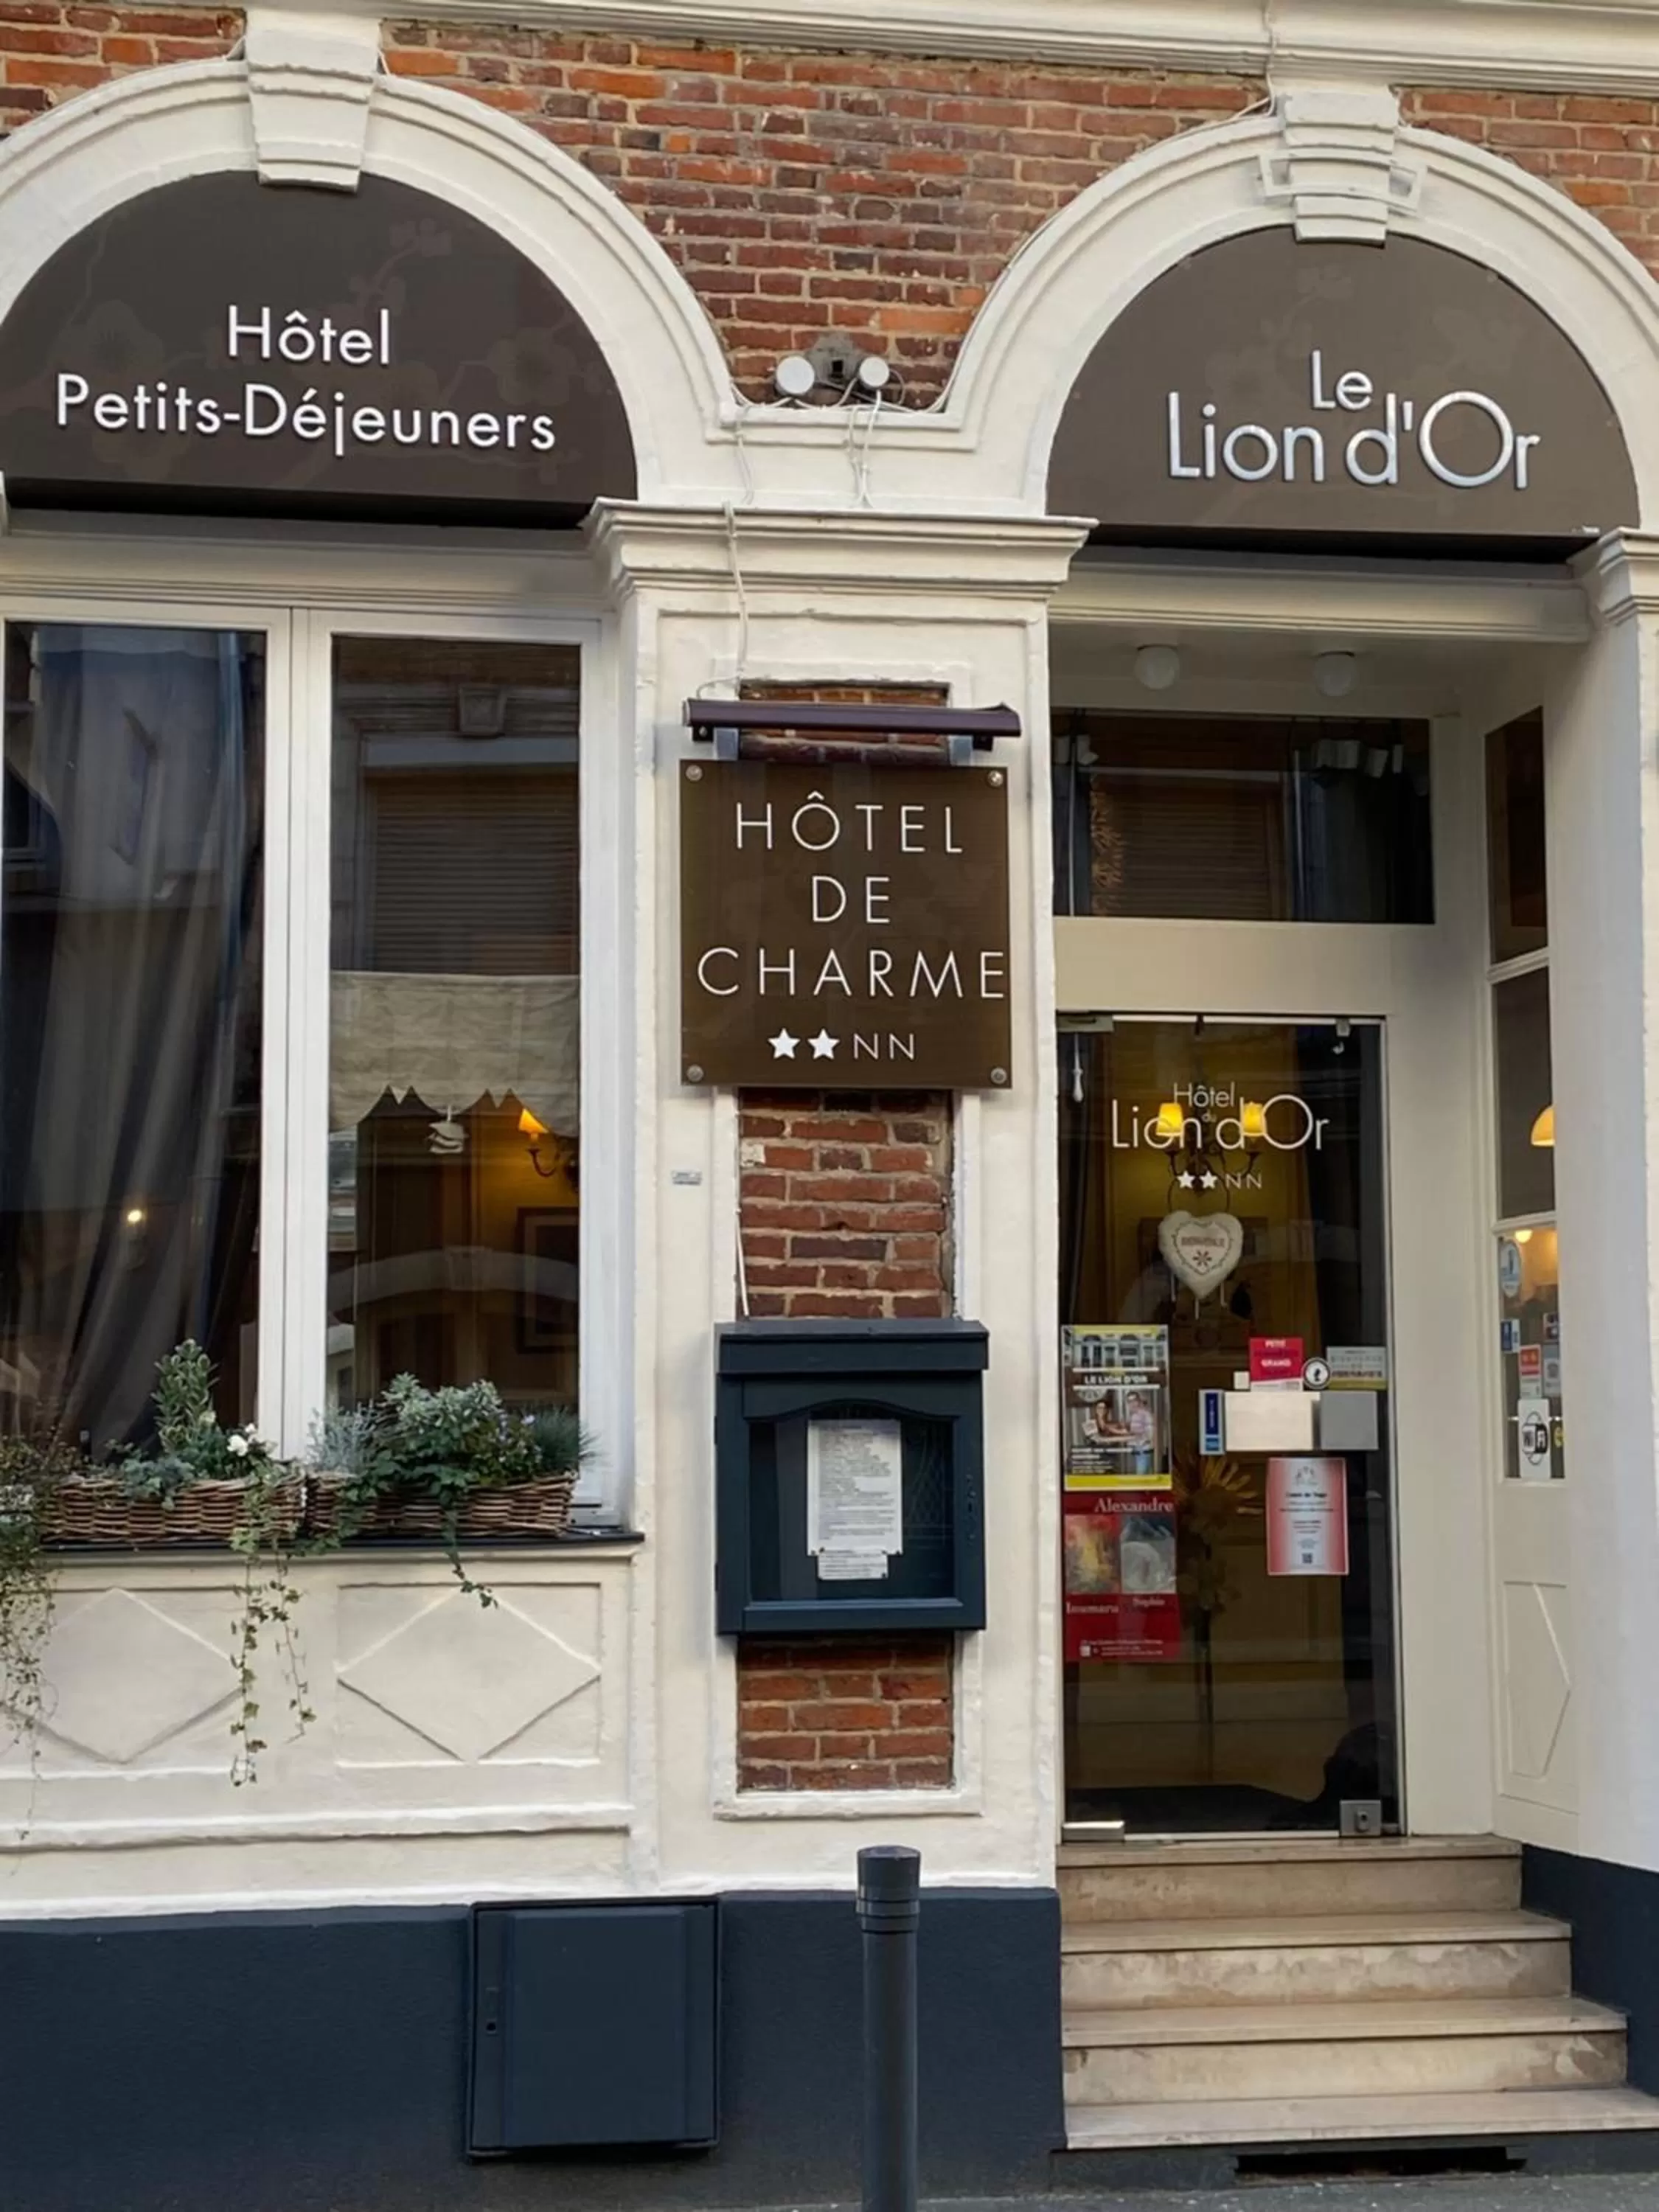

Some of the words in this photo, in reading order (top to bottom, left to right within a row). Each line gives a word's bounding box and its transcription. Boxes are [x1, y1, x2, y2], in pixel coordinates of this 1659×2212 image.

[228, 305, 390, 365] Hôtel
[1310, 349, 1373, 411] Le
[56, 373, 555, 456] Petits-Déjeuners
[1167, 392, 1325, 481] Lion
[1346, 390, 1541, 490] d'Or
[736, 790, 963, 854] HÔTEL
[811, 875, 891, 924] DE
[697, 947, 1005, 999] CHARME
[853, 1032, 916, 1060] NN
[1173, 1081, 1236, 1108] Hôtel
[1111, 1099, 1203, 1150] Lion
[1215, 1093, 1330, 1151] dOr
[1225, 1173, 1263, 1189] NN
[1084, 1375, 1097, 1384] LE
[1094, 1497, 1174, 1513] Alexandre
